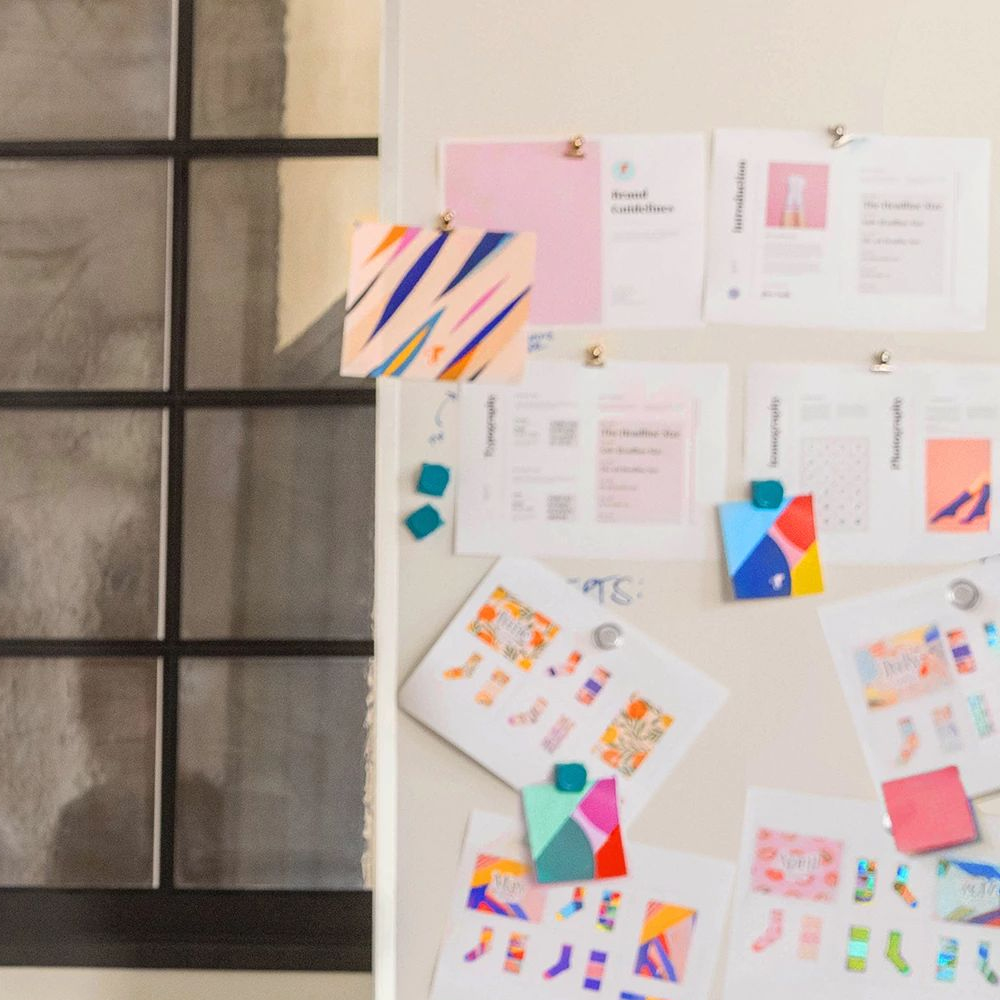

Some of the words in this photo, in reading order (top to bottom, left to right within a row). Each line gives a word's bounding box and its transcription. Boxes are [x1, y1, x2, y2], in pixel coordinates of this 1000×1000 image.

[610, 188, 649, 201] Brand
[610, 202, 675, 215] Guidelines
[731, 159, 747, 234] Introduction
[483, 394, 497, 458] Typography
[766, 396, 782, 469] Iconography
[889, 396, 904, 470] Photography
